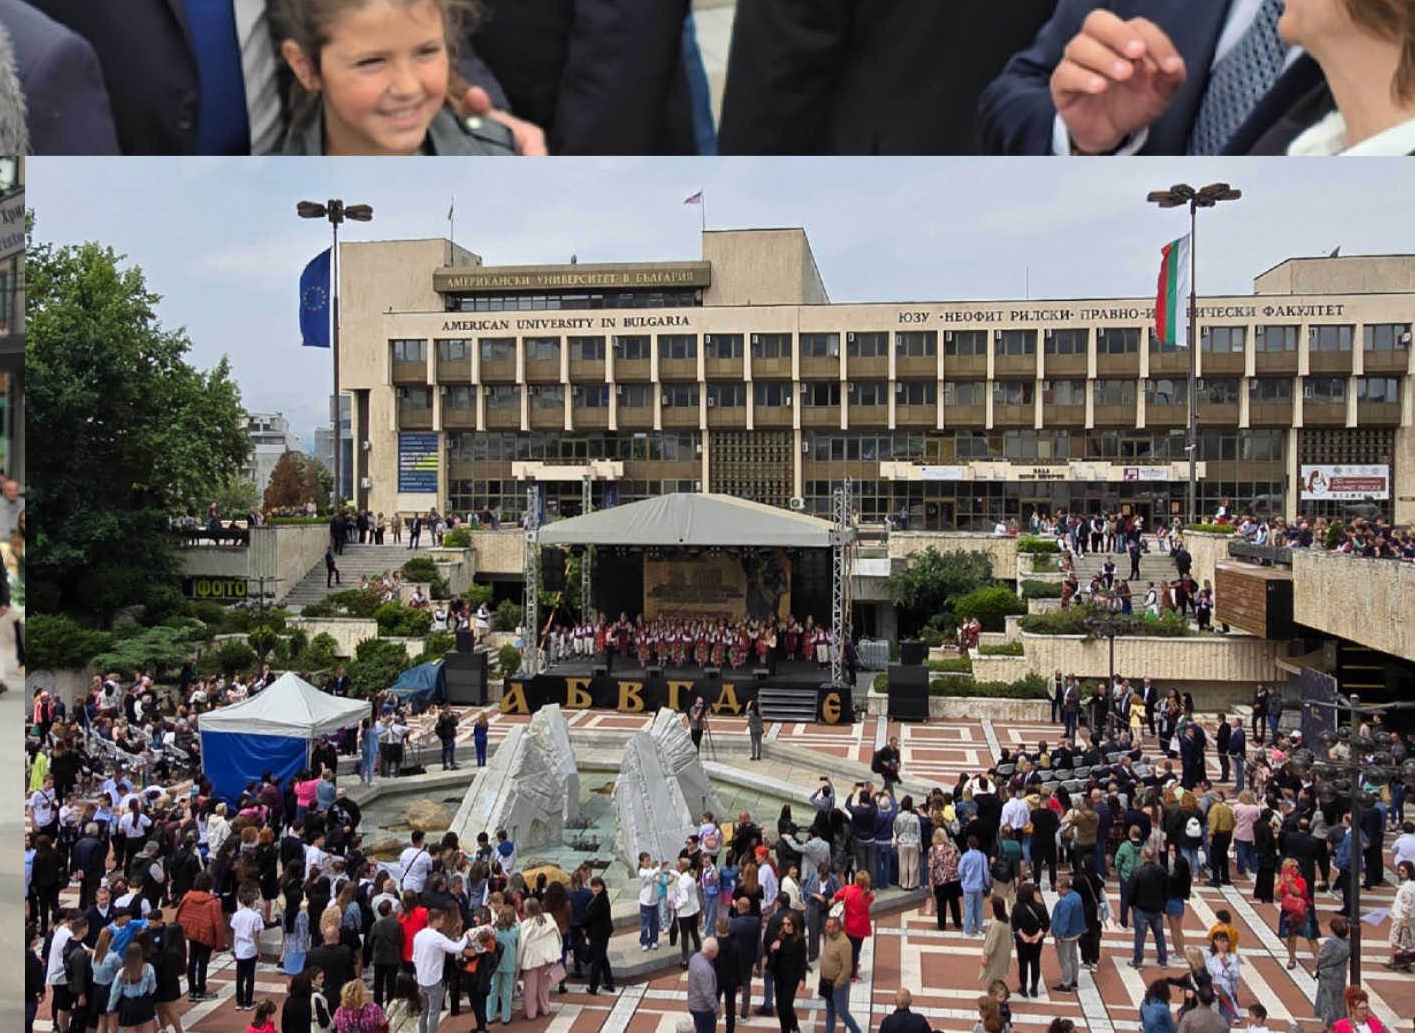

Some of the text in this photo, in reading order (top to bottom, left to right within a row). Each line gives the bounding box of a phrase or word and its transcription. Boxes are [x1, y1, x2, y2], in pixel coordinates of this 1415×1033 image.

[447, 270, 695, 288] АМЕРИКАНСКИ УНИВЕРСИТЕТ В БЪЛГАРИЯ
[898, 311, 931, 324] ЮЗУ
[1261, 303, 1346, 318] ФАКУЛТЕТ
[442, 314, 691, 332] AMERICAN UNIVERSITY IN BULGARIA
[197, 579, 247, 597] ФОТО
[500, 682, 530, 714] А
[565, 677, 592, 708] Б
[618, 680, 645, 712] В
[667, 680, 694, 711] Г
[712, 683, 742, 715] Д
